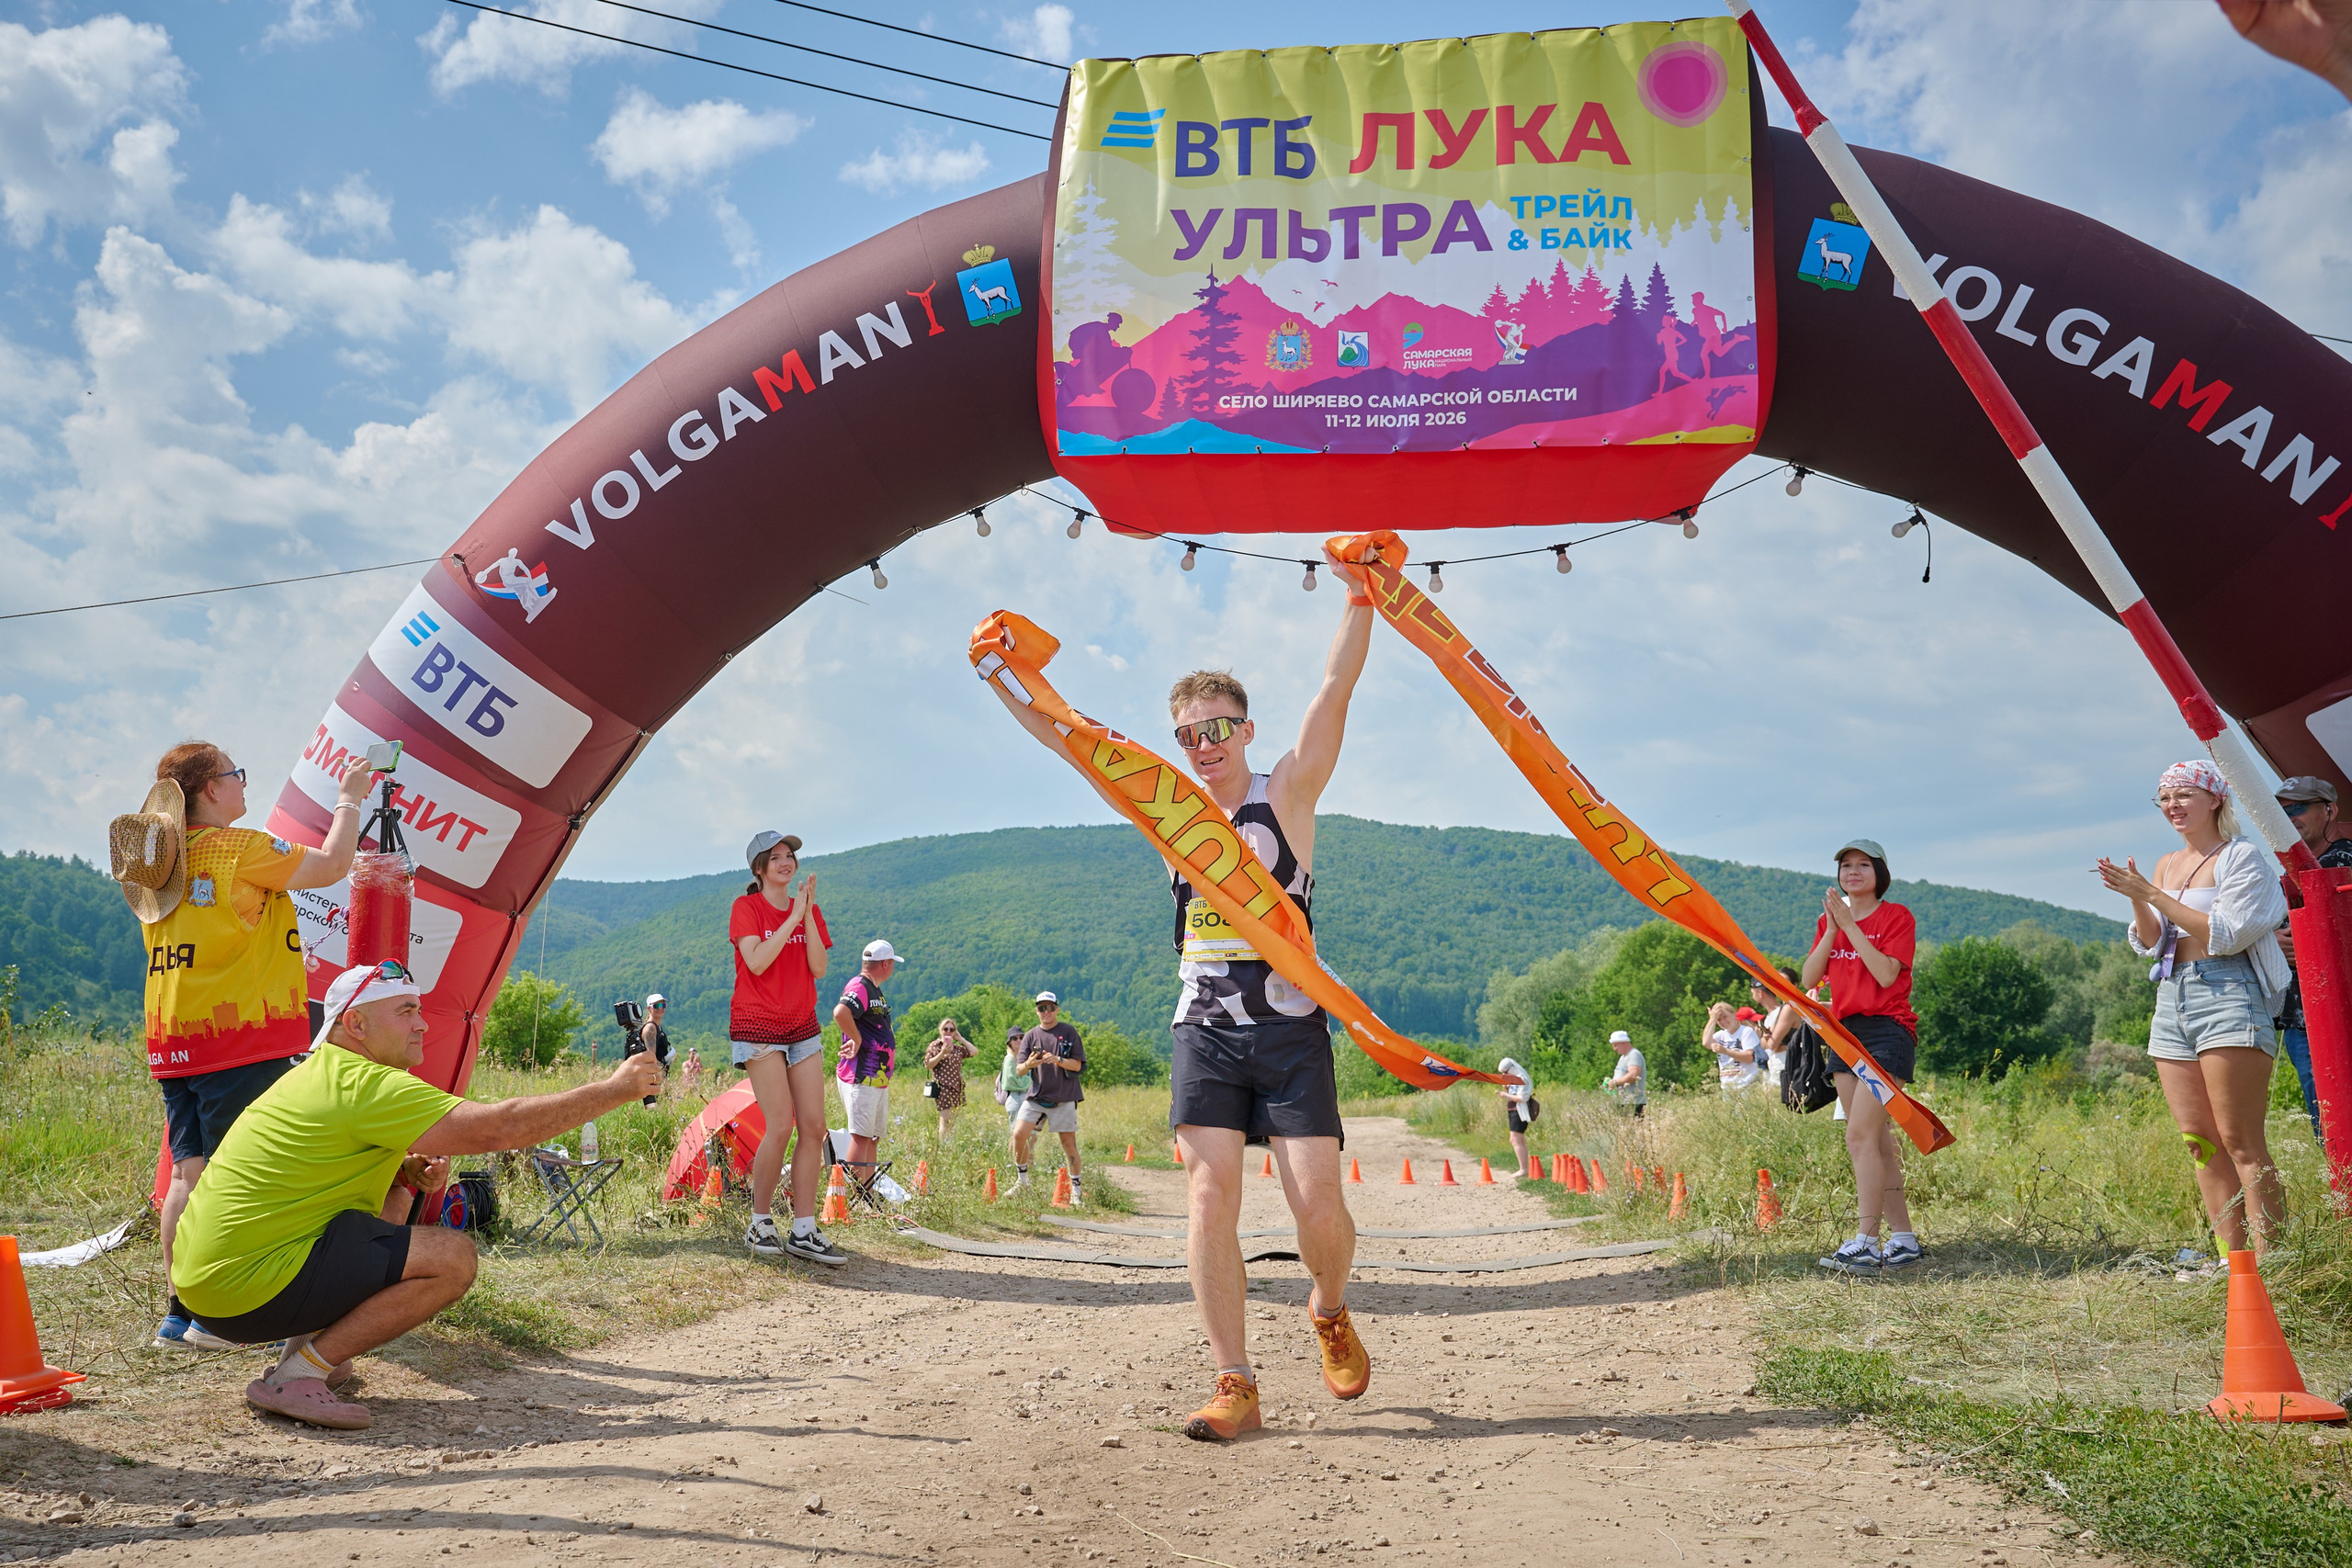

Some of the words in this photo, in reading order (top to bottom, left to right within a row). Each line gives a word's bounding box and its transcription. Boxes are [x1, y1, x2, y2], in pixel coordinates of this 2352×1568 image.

[1175, 115, 1317, 180] ВТБ
[1349, 101, 1632, 174] ЛУКА
[1510, 187, 1633, 220] ТРЕЙЛ
[1170, 199, 1493, 264] УЛЬТРА
[1508, 229, 1529, 251] &
[1540, 221, 1633, 250] БАЙК
[1403, 348, 1473, 360] САМАРСКАЯ
[1403, 359, 1435, 369] ЛУКА
[1219, 395, 1268, 409] СЕЛО
[1272, 394, 1363, 408] ШИРЯЕВО
[1367, 388, 1482, 408] САМАРСКОЙ
[1487, 388, 1577, 405] ОБЛАСТИ
[545, 300, 913, 551] VOLGAMAN
[1325, 414, 1362, 427] 11-12
[1365, 412, 1419, 428] ИЮЛЯ
[1425, 411, 1467, 426] 2026
[412, 641, 518, 738] ВТБ
[1091, 739, 1281, 919] LUKA
[1194, 900, 1207, 908] ВТБ
[150, 943, 196, 976] ДЬЯ
